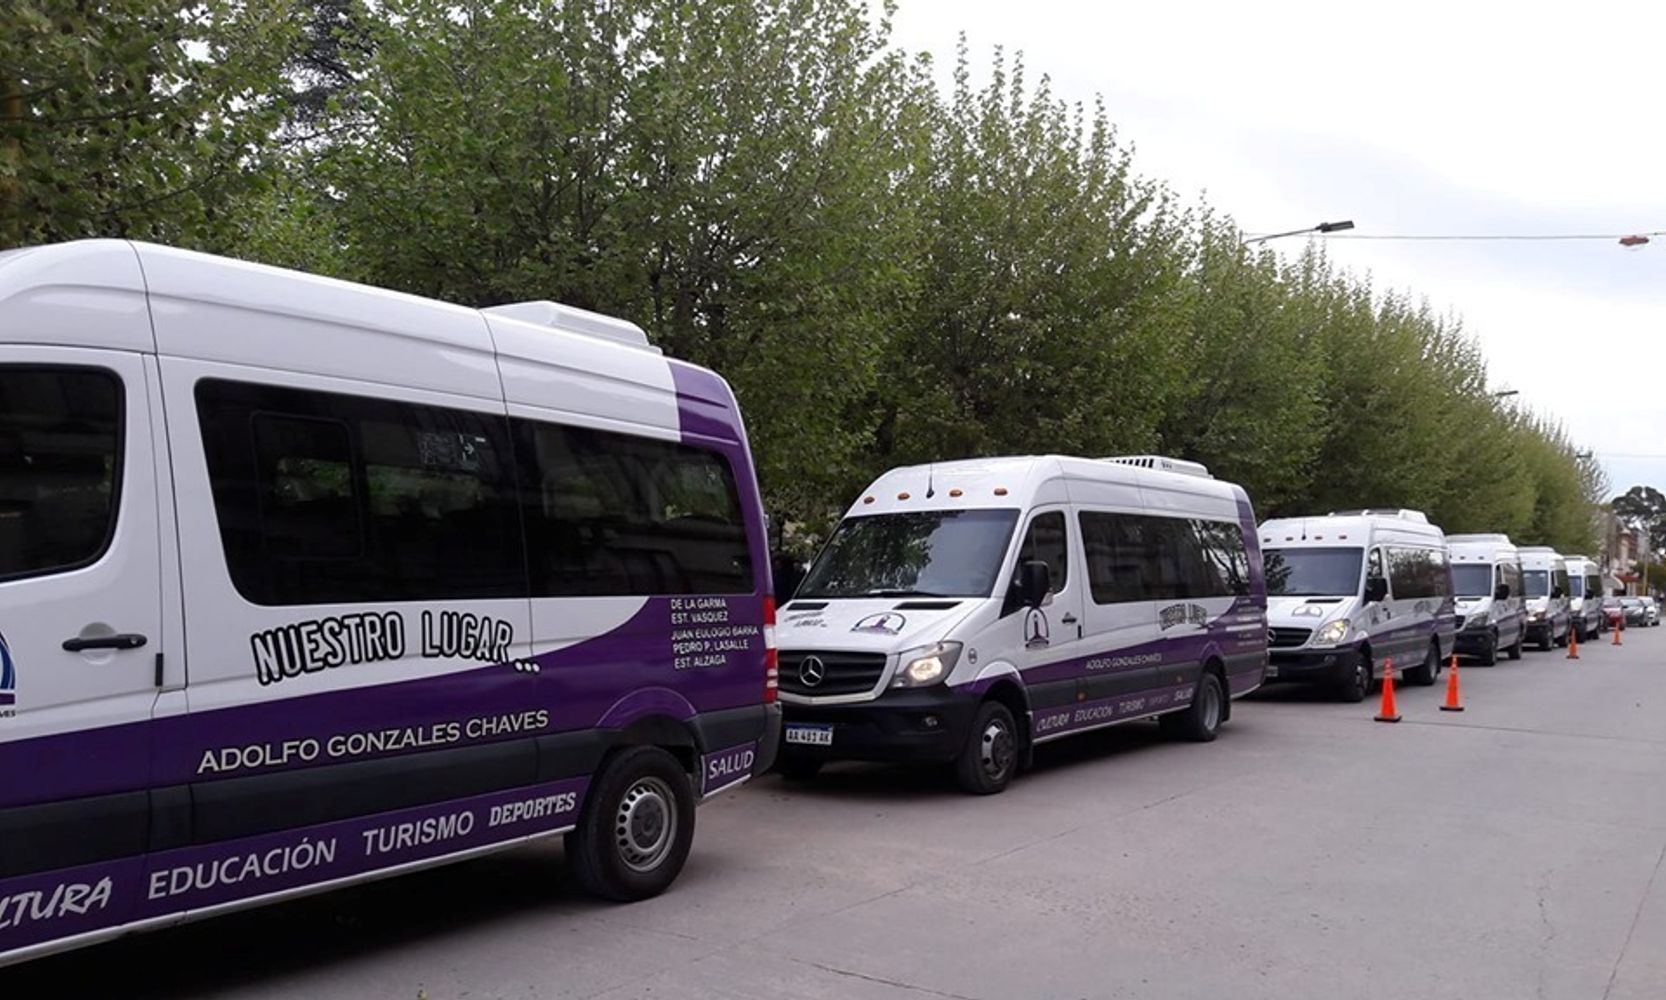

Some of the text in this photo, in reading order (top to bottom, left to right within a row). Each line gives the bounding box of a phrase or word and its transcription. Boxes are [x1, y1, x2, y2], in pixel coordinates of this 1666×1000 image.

[671, 598, 727, 610] DE LA GARMA
[691, 611, 728, 622] VASQUEZ
[671, 626, 759, 640] JUAN EULOGIO BARRA
[251, 611, 405, 686] NUESTRO
[673, 641, 703, 654] PEDRO
[714, 639, 749, 651] LASALLE
[694, 654, 726, 666] ALZAGA
[197, 709, 549, 774] ADOLFO GONZALES CHAVES
[148, 837, 337, 900] EDUCACIÓN
[362, 811, 474, 855] TURISMO
[488, 791, 577, 827] DEPORTES
[708, 750, 754, 780] SALUD
